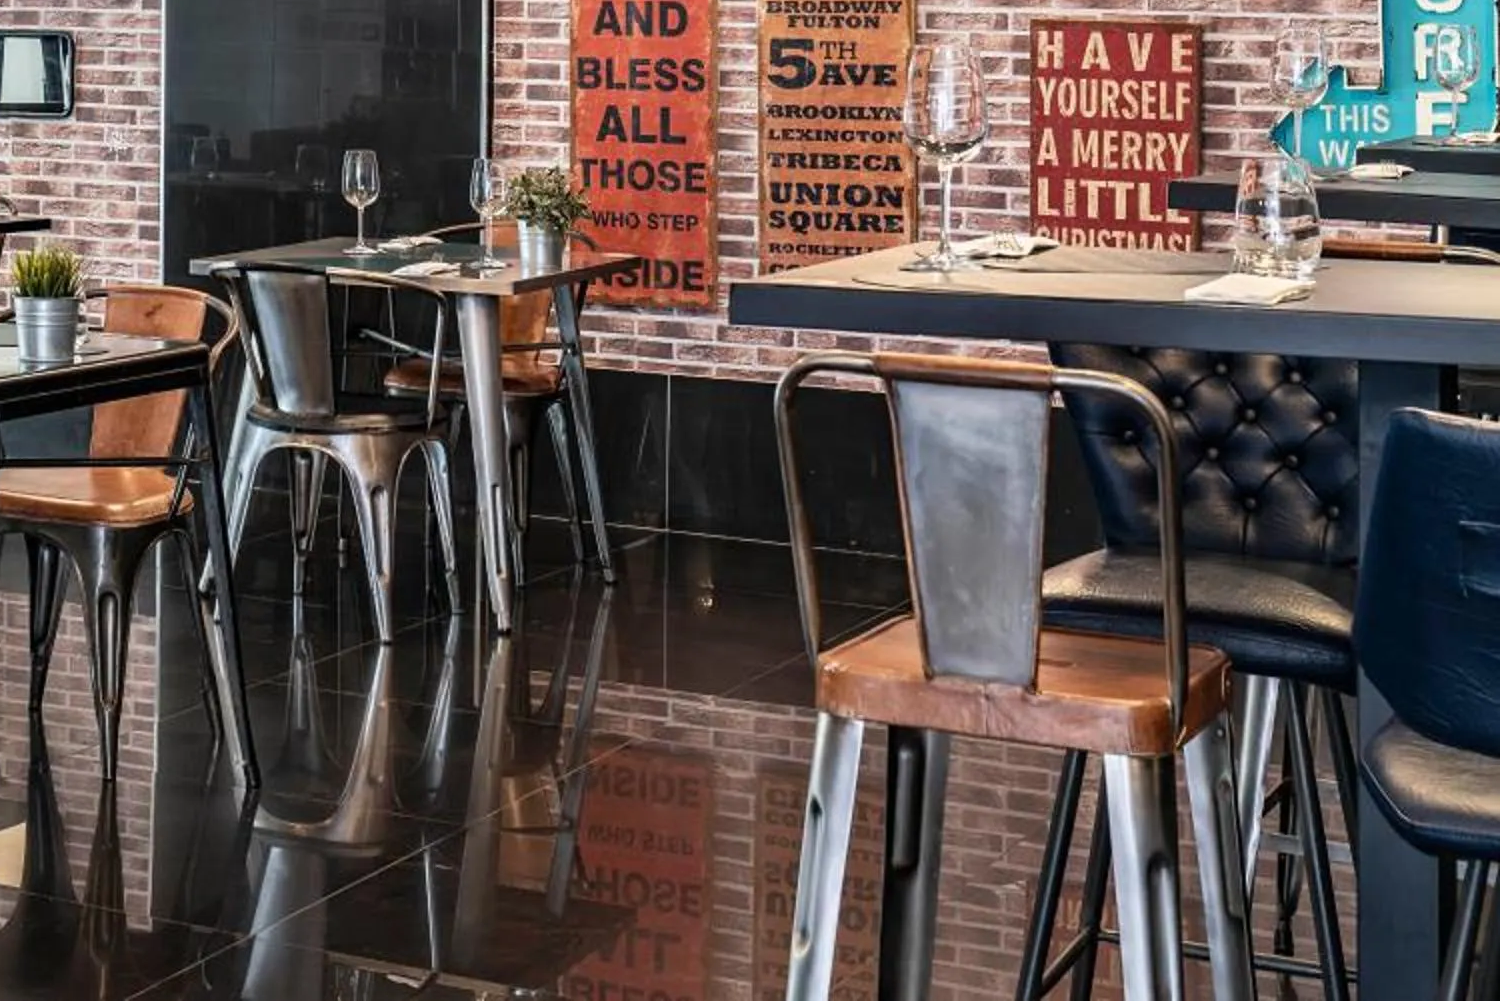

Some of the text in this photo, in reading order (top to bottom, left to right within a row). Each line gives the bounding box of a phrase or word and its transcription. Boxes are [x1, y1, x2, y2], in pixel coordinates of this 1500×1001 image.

[593, 0, 689, 38] AND
[766, 0, 902, 14] BROADWAY
[787, 14, 881, 29] FULTON
[1037, 30, 1193, 73] HAVE
[576, 57, 706, 93] BLESS
[819, 63, 898, 87] AVE
[767, 104, 903, 121] BROOKLYN
[1037, 76, 1192, 122] YOURSELF
[595, 104, 687, 145] ALL
[1320, 102, 1391, 134] THIS
[768, 128, 903, 144] LEXINGTON
[768, 152, 903, 172] TRIBECA
[1037, 127, 1191, 173] A MERRY
[578, 158, 707, 194] THOSE
[769, 182, 905, 209] UNION
[592, 210, 699, 232] WHO STEP
[768, 210, 904, 235] SQUARE
[769, 242, 887, 257] ROCKEFEL
[591, 257, 705, 291] SIDE
